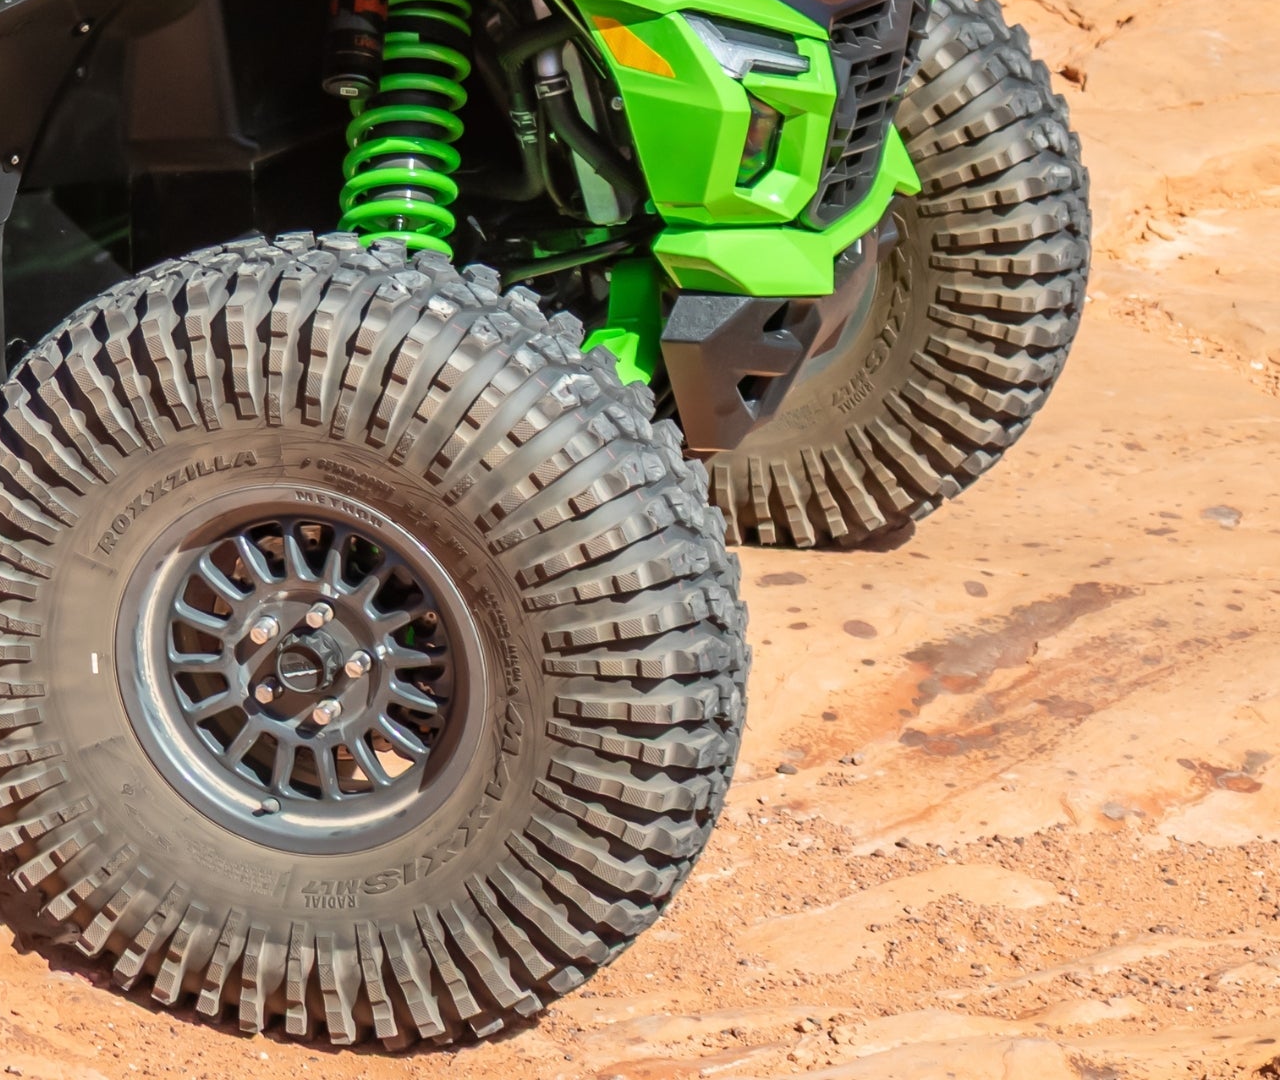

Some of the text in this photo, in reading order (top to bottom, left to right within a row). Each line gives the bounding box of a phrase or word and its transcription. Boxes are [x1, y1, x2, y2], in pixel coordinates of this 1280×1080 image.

[96, 449, 258, 557] ROXXZILLA
[363, 700, 525, 897] MAXXIS
[303, 894, 359, 910] RADIAL
